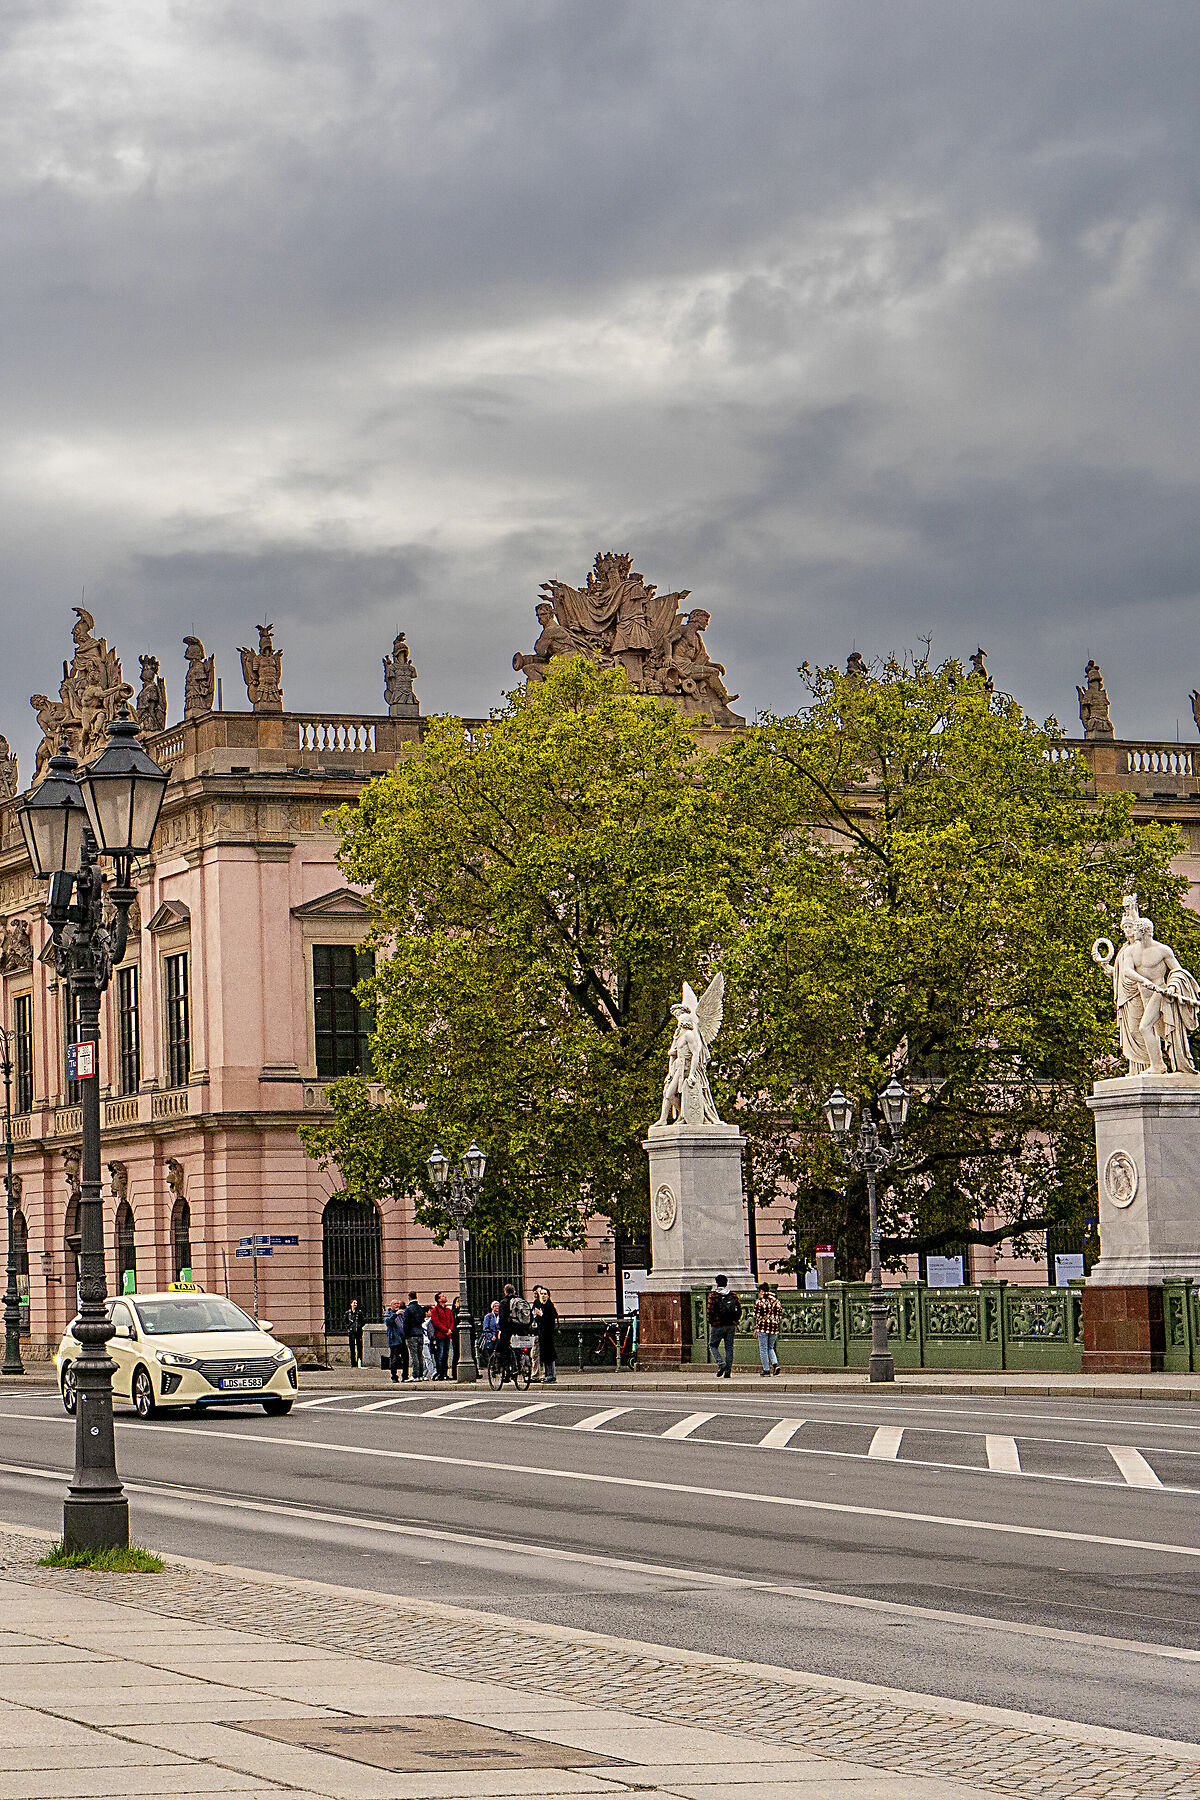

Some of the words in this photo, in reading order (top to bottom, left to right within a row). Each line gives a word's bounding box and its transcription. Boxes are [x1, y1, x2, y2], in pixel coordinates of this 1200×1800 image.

[623, 1271, 631, 1280] D
[175, 1283, 196, 1291] TAXI
[223, 1379, 239, 1388] LDS
[242, 1379, 248, 1387] E
